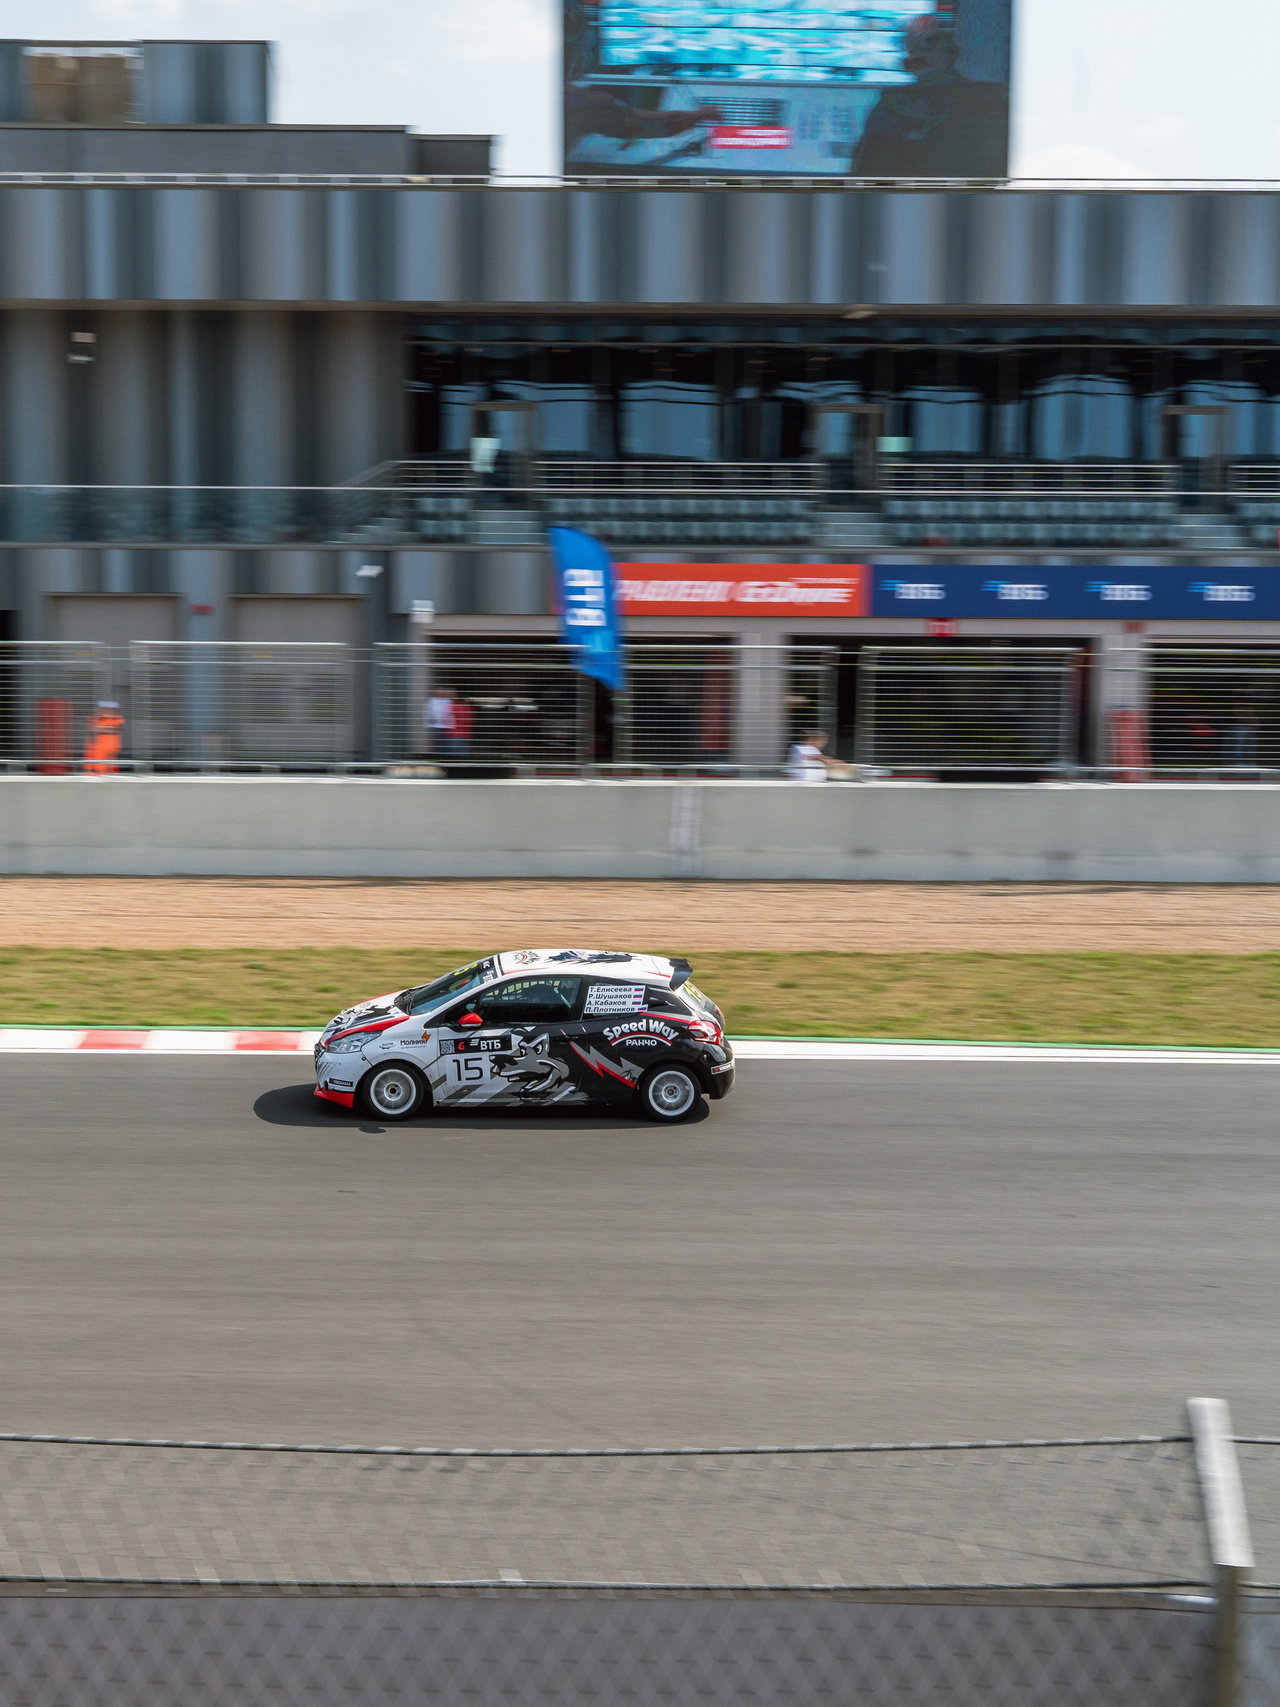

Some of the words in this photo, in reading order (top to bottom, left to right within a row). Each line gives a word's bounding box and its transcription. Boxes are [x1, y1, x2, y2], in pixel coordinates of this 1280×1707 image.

[602, 1018, 647, 1041] Speed
[648, 1019, 680, 1041] Way
[480, 1040, 501, 1050] ВТБ
[452, 1057, 483, 1081] 15
